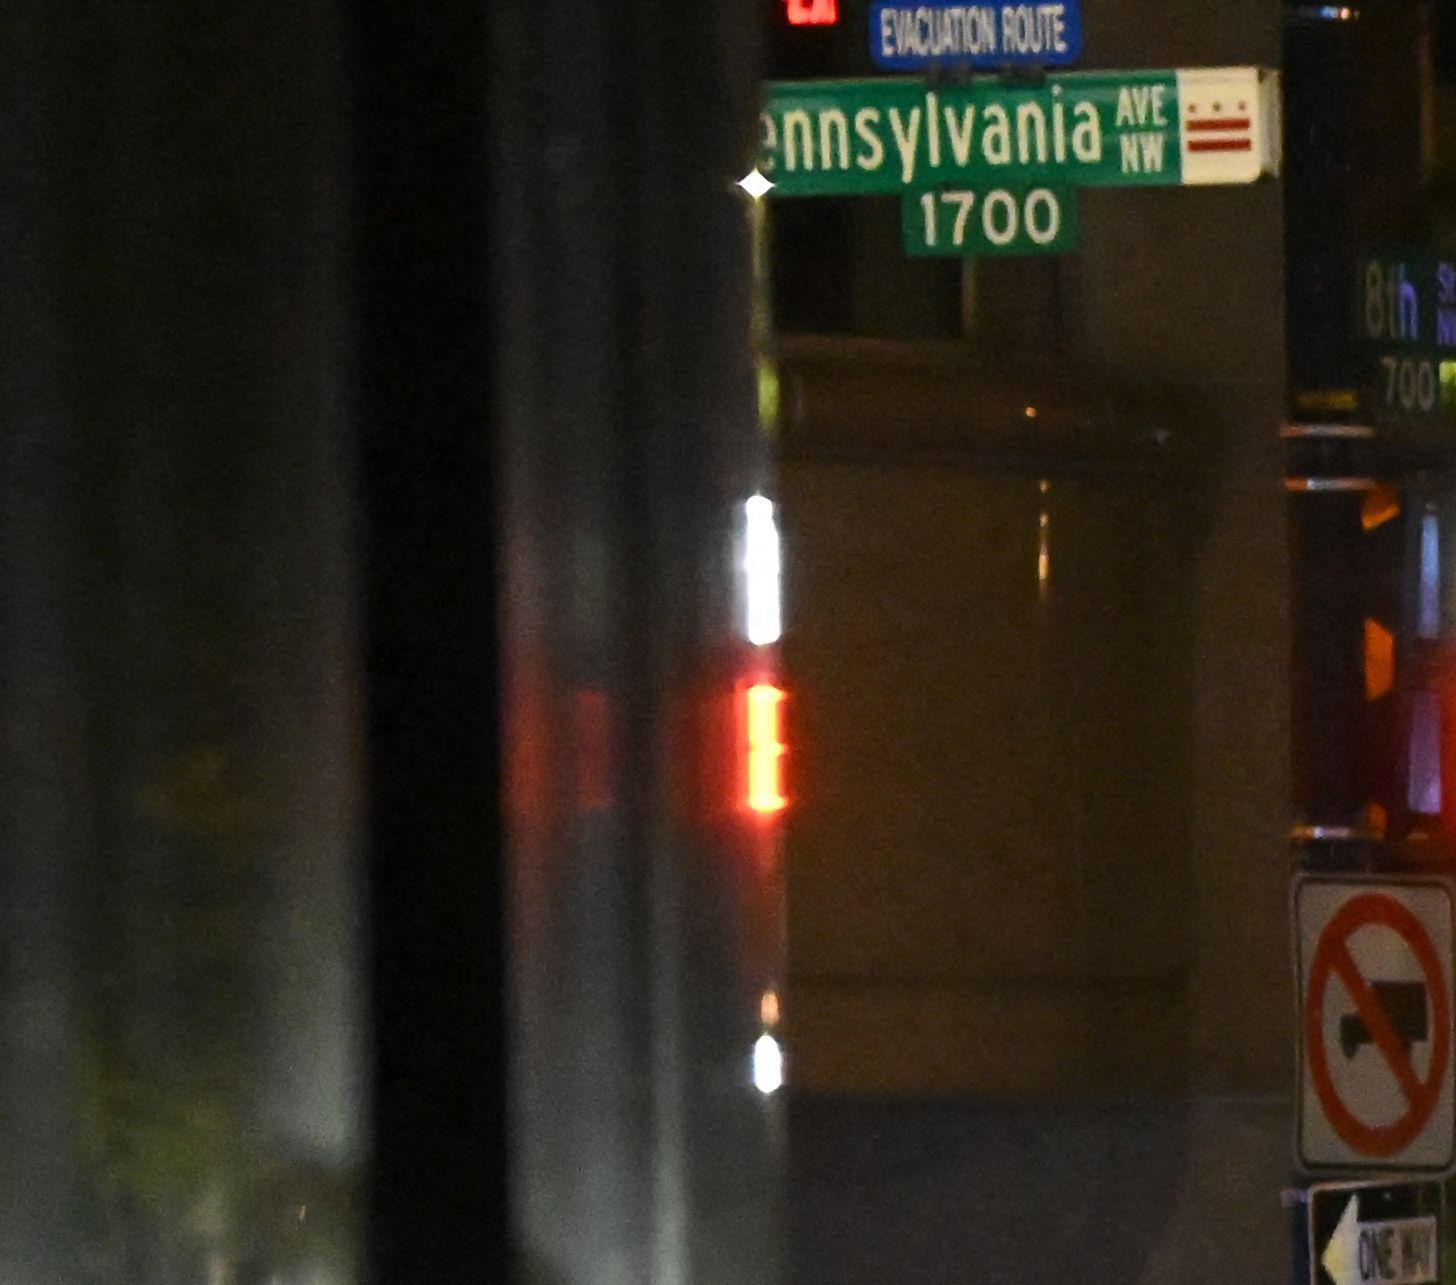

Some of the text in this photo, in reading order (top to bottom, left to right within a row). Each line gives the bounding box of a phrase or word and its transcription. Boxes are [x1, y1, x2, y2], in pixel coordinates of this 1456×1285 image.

[880, 7, 995, 57] EVACUATION
[1003, 5, 1067, 53] ROUTE
[1116, 85, 1167, 128] AVE
[1120, 132, 1165, 173] NW
[921, 188, 1061, 246] 1700
[1380, 353, 1434, 411] 700
[1359, 1227, 1396, 1281] ONE
